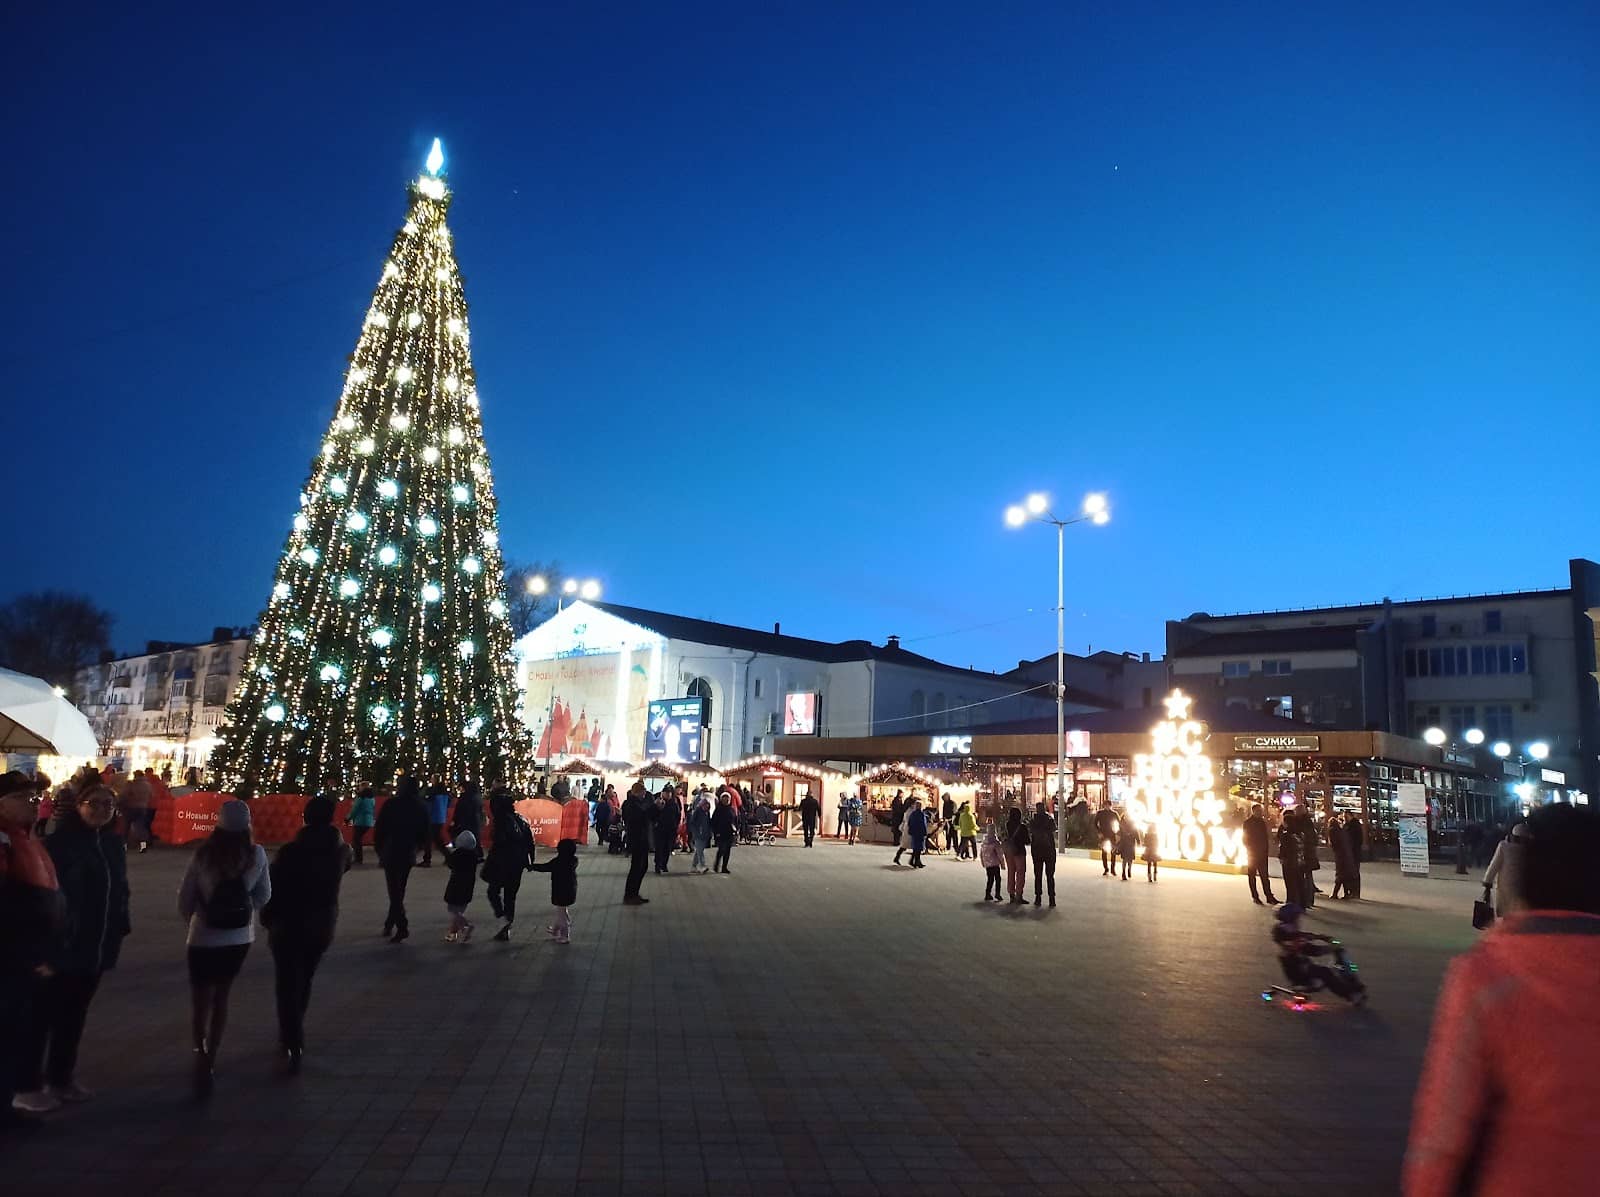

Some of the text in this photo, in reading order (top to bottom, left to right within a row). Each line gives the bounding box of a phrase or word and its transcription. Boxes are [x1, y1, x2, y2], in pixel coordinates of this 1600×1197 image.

[929, 736, 973, 754] KFC
[1255, 737, 1297, 746] СУМКИ
[178, 811, 184, 819] С
